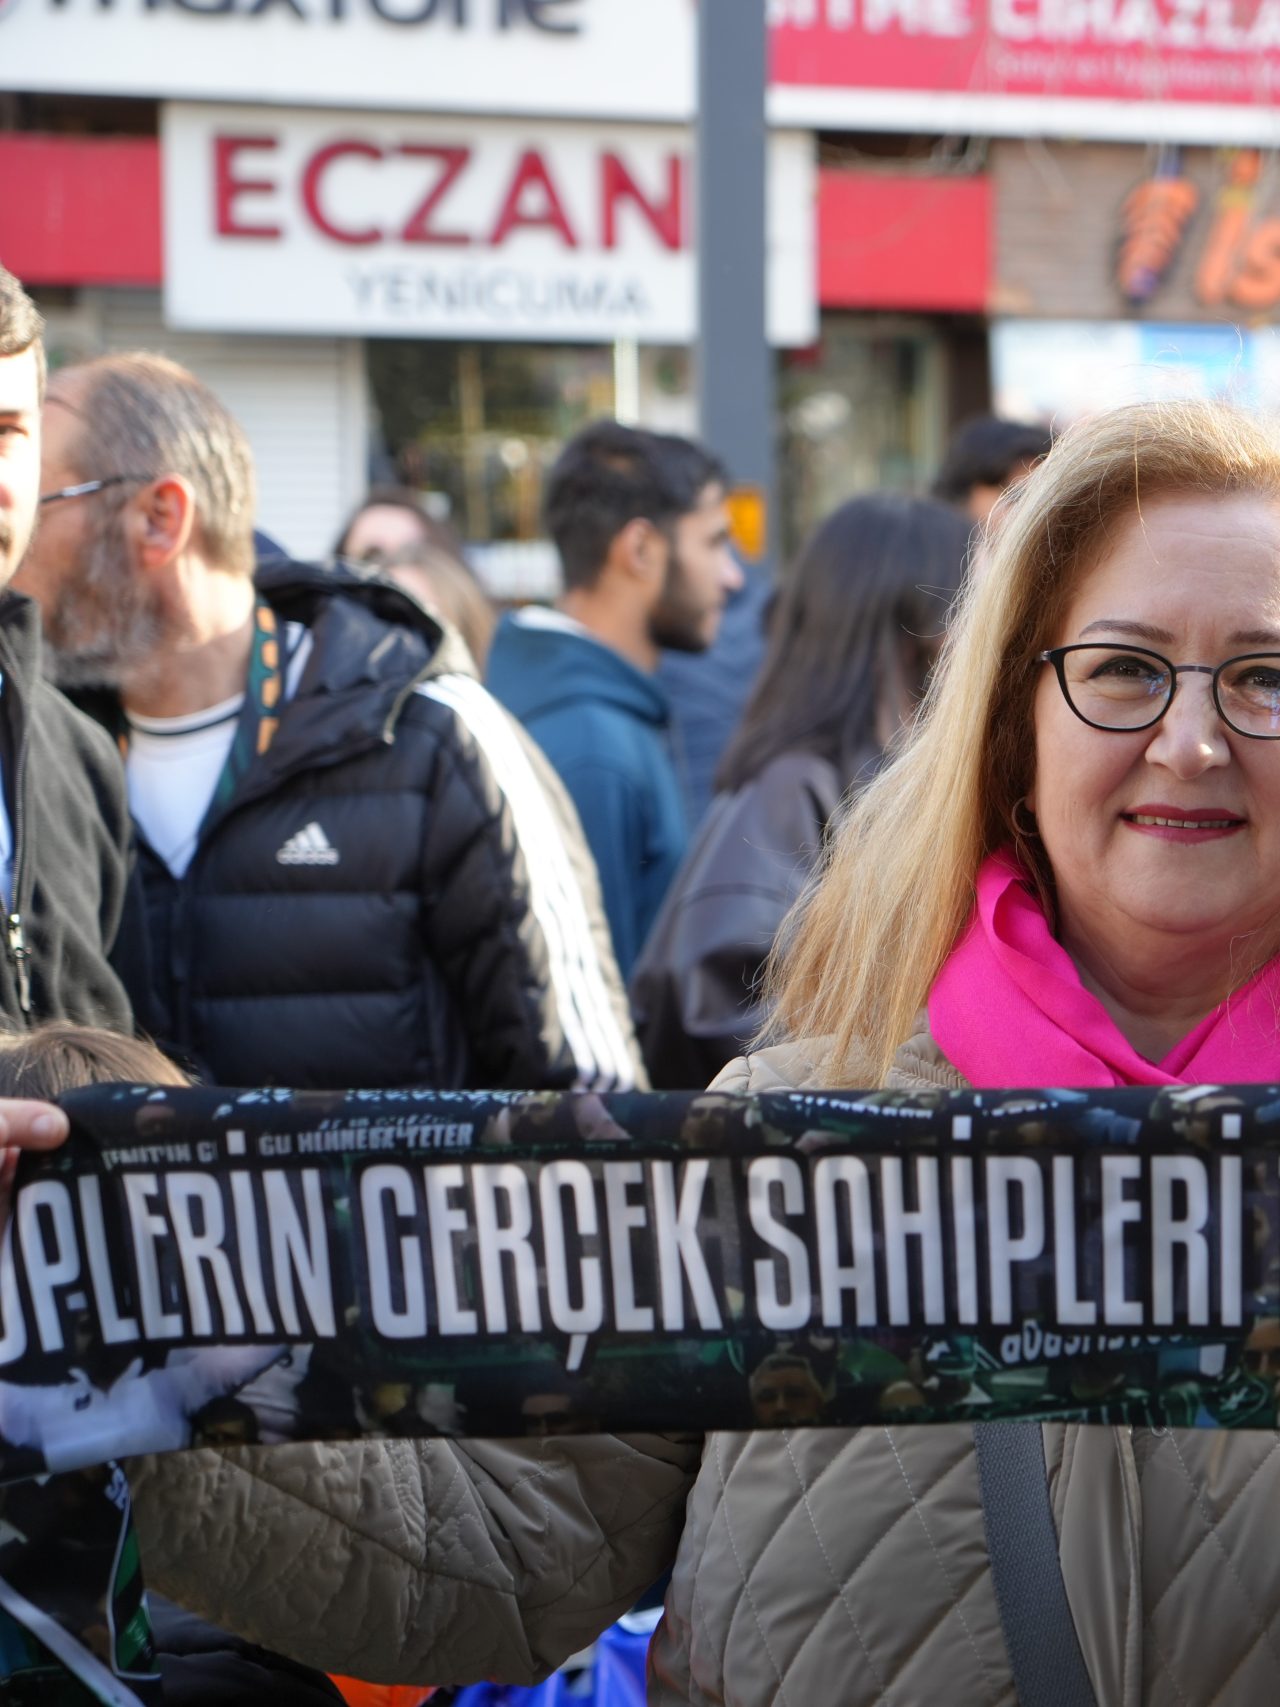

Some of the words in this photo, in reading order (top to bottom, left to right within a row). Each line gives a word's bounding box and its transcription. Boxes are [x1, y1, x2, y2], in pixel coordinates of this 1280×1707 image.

[211, 135, 686, 252] ECZAN
[360, 1158, 723, 1371] GERÇEK
[747, 1114, 1241, 1331] SAHİPLERİ
